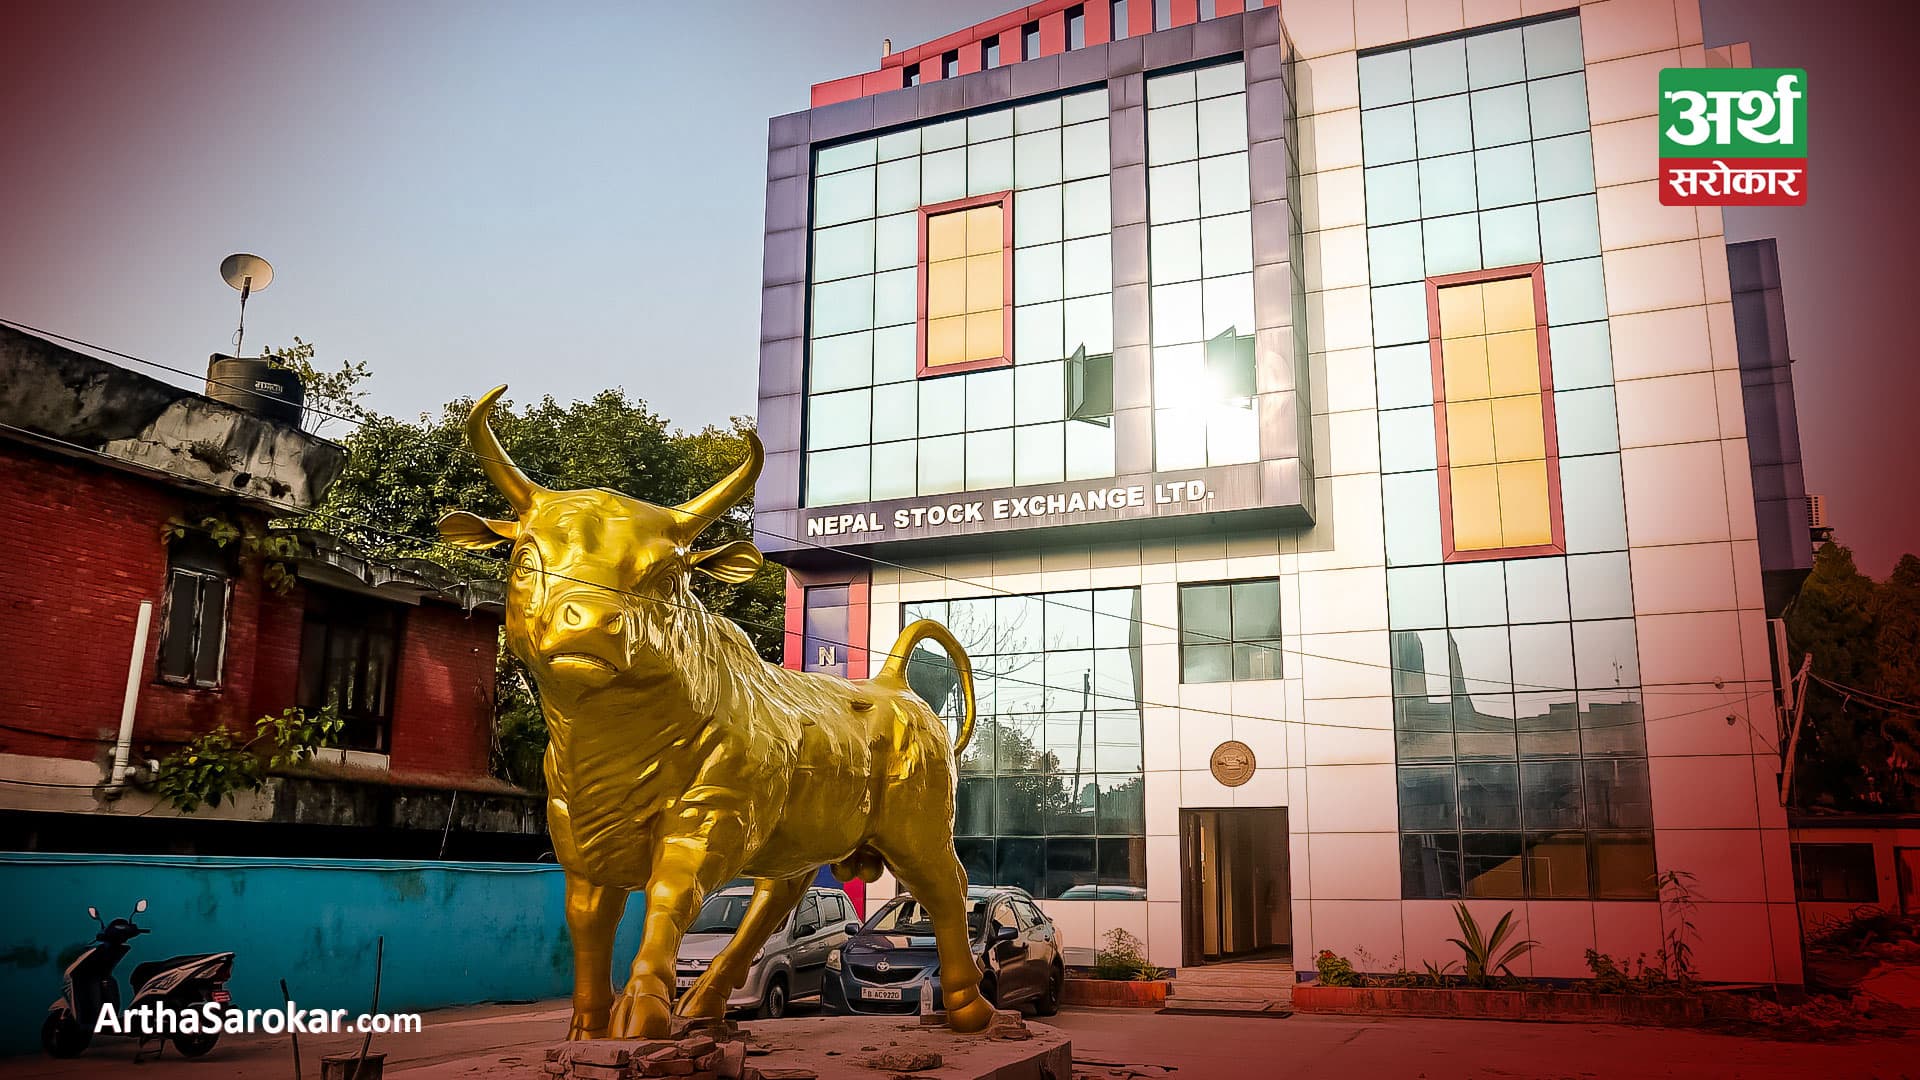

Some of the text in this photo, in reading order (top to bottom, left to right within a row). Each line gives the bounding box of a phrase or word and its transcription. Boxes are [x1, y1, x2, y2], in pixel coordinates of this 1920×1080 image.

[807, 480, 1215, 537] NEPAL STOCK EXCHANGE LTD.
